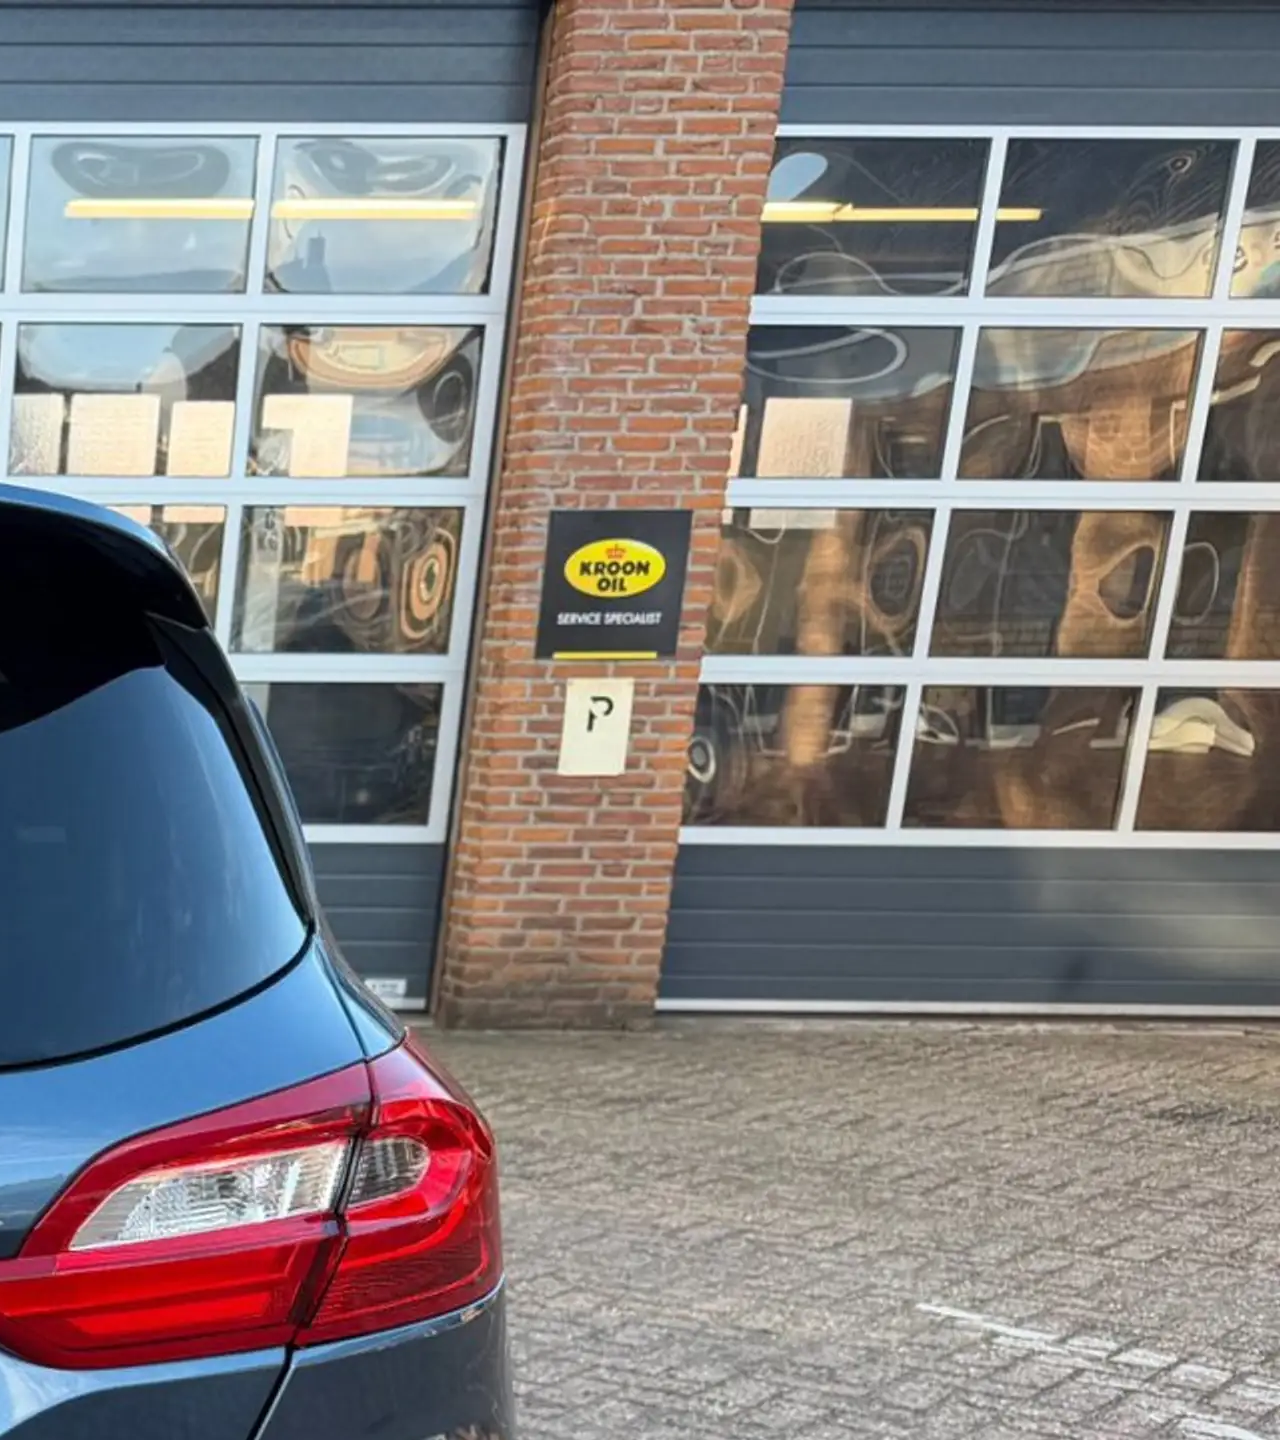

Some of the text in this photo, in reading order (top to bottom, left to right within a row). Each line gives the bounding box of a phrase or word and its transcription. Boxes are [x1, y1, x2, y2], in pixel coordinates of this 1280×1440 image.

[579, 560, 650, 576] KROON
[596, 577, 627, 592] OIL
[556, 611, 663, 626] SERVICE SPECIALIST
